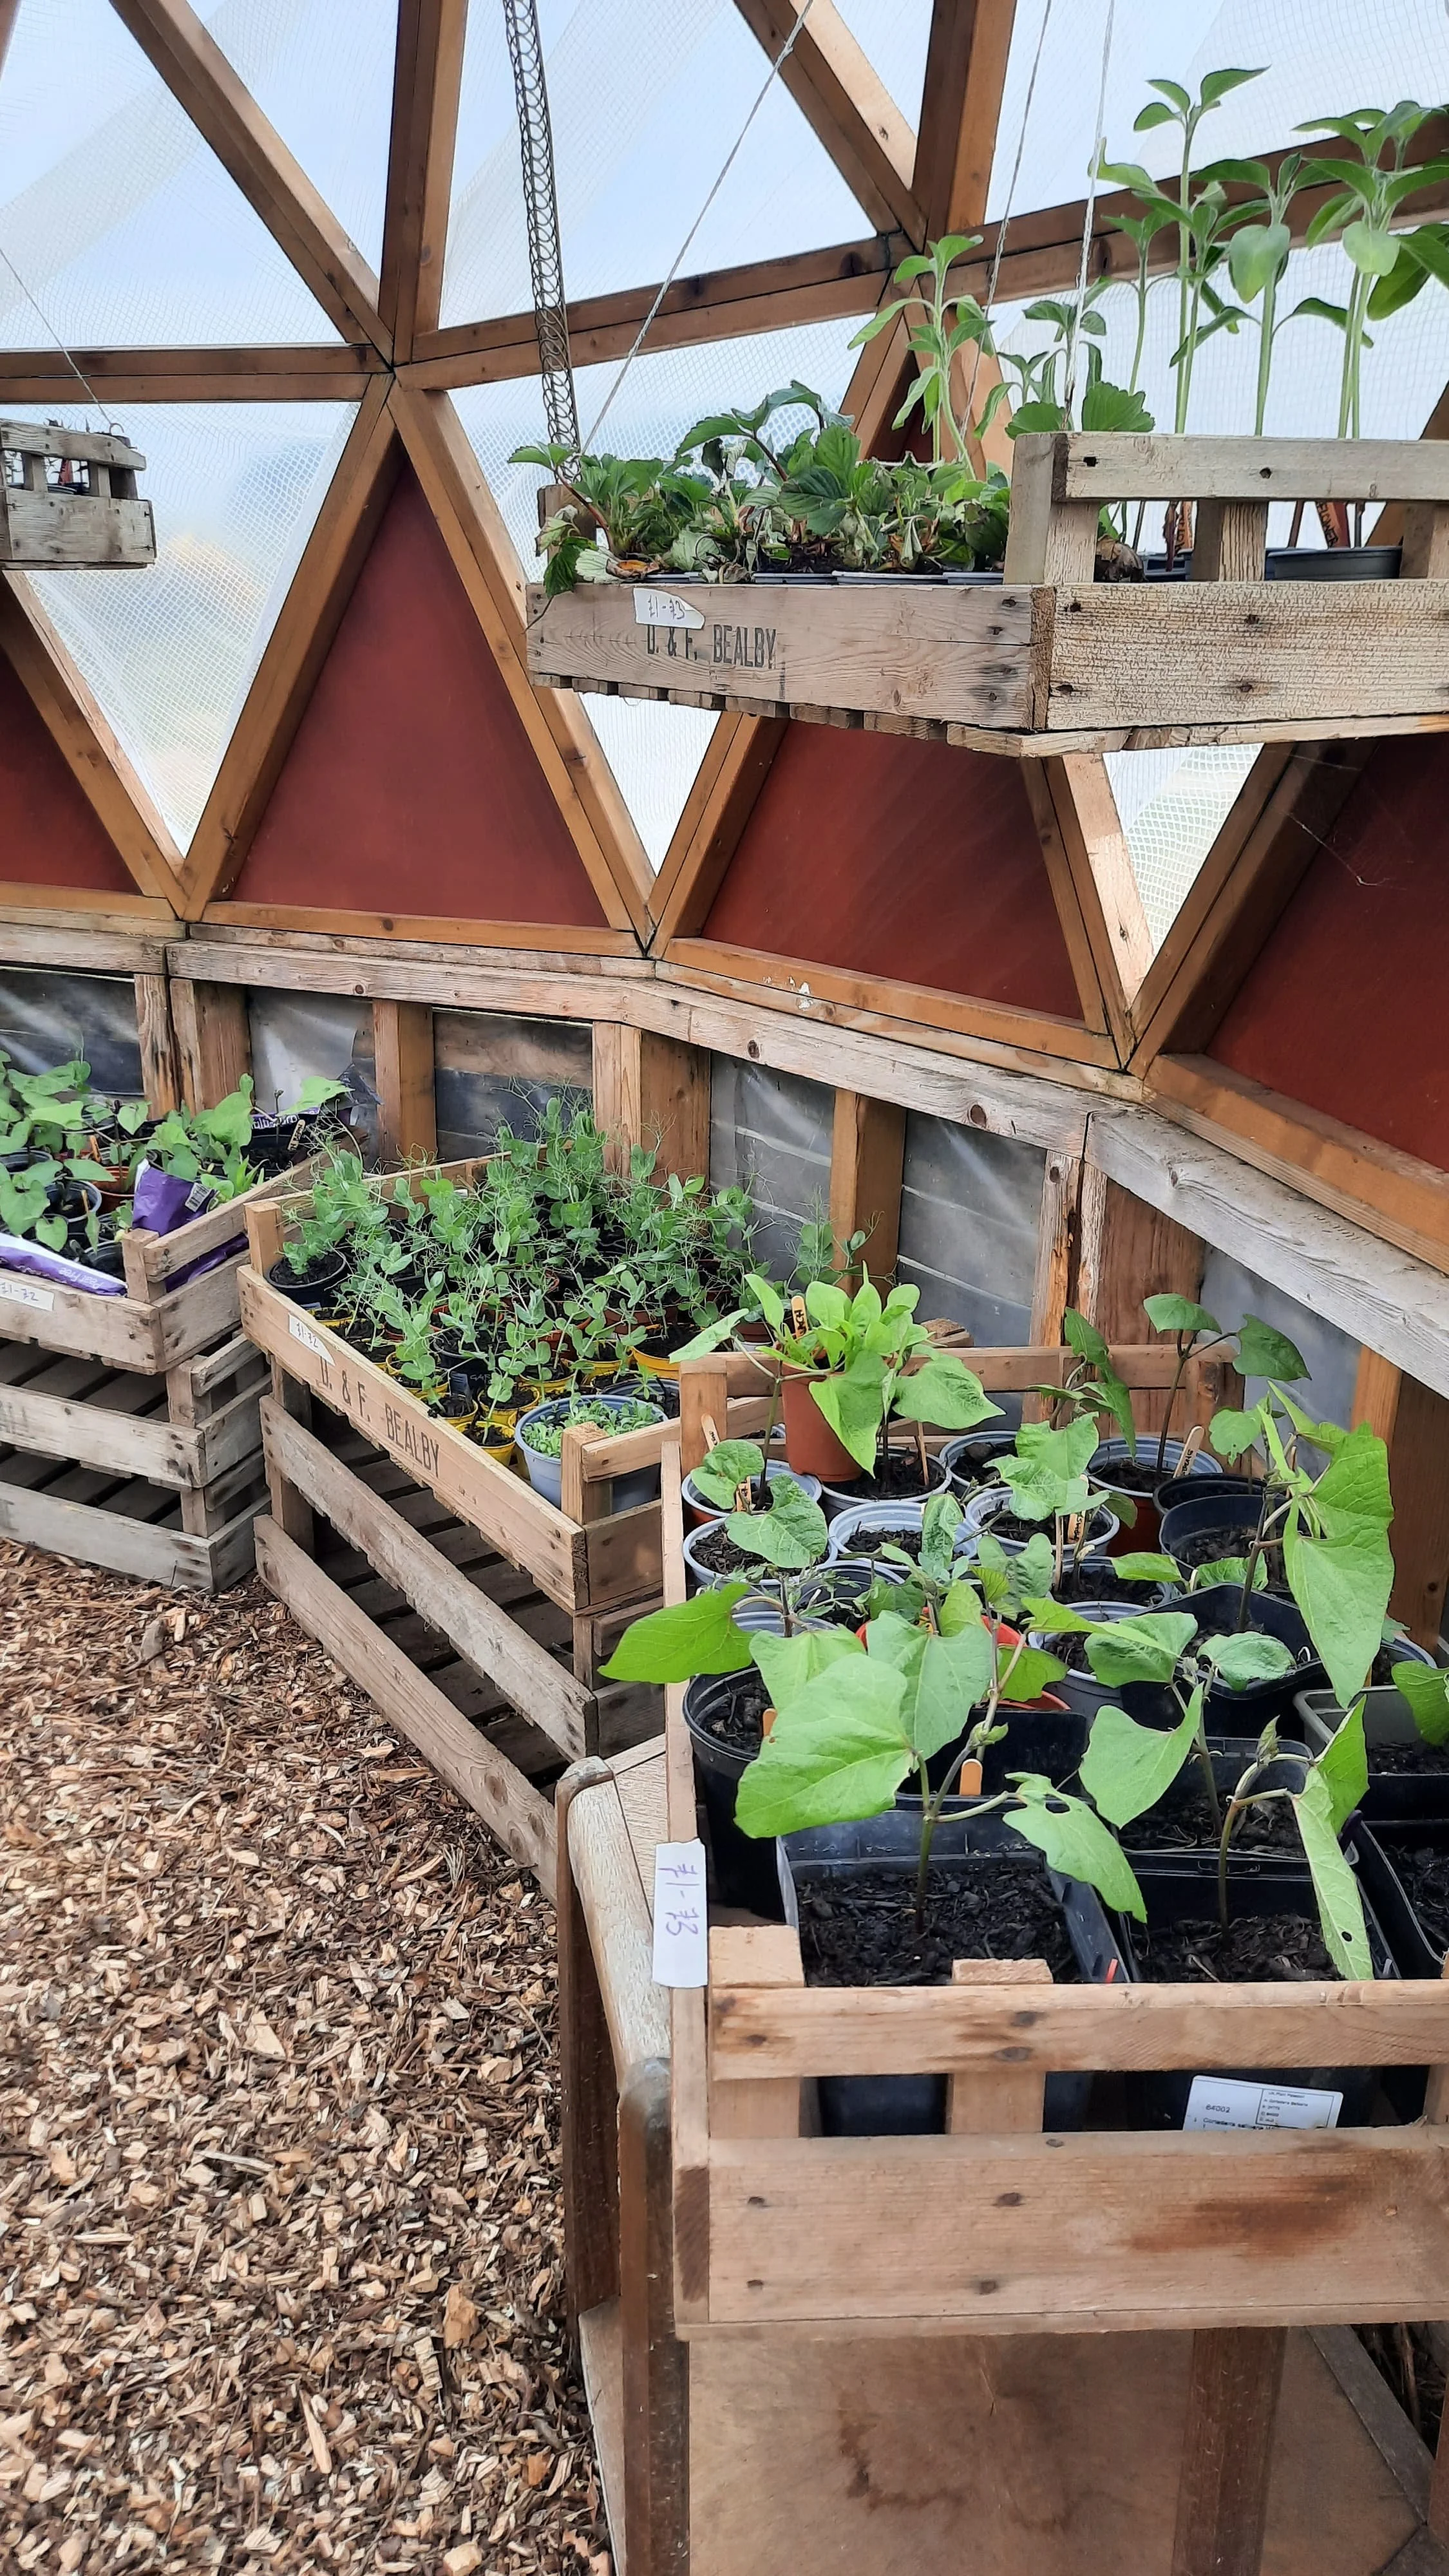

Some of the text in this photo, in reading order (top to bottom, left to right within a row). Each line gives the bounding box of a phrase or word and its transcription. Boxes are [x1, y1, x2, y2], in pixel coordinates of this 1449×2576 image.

[713, 624, 776, 669] BEALBY
[342, 1370, 352, 1406] &
[358, 1381, 371, 1423] F.
[385, 1403, 439, 1477] BEALBY
